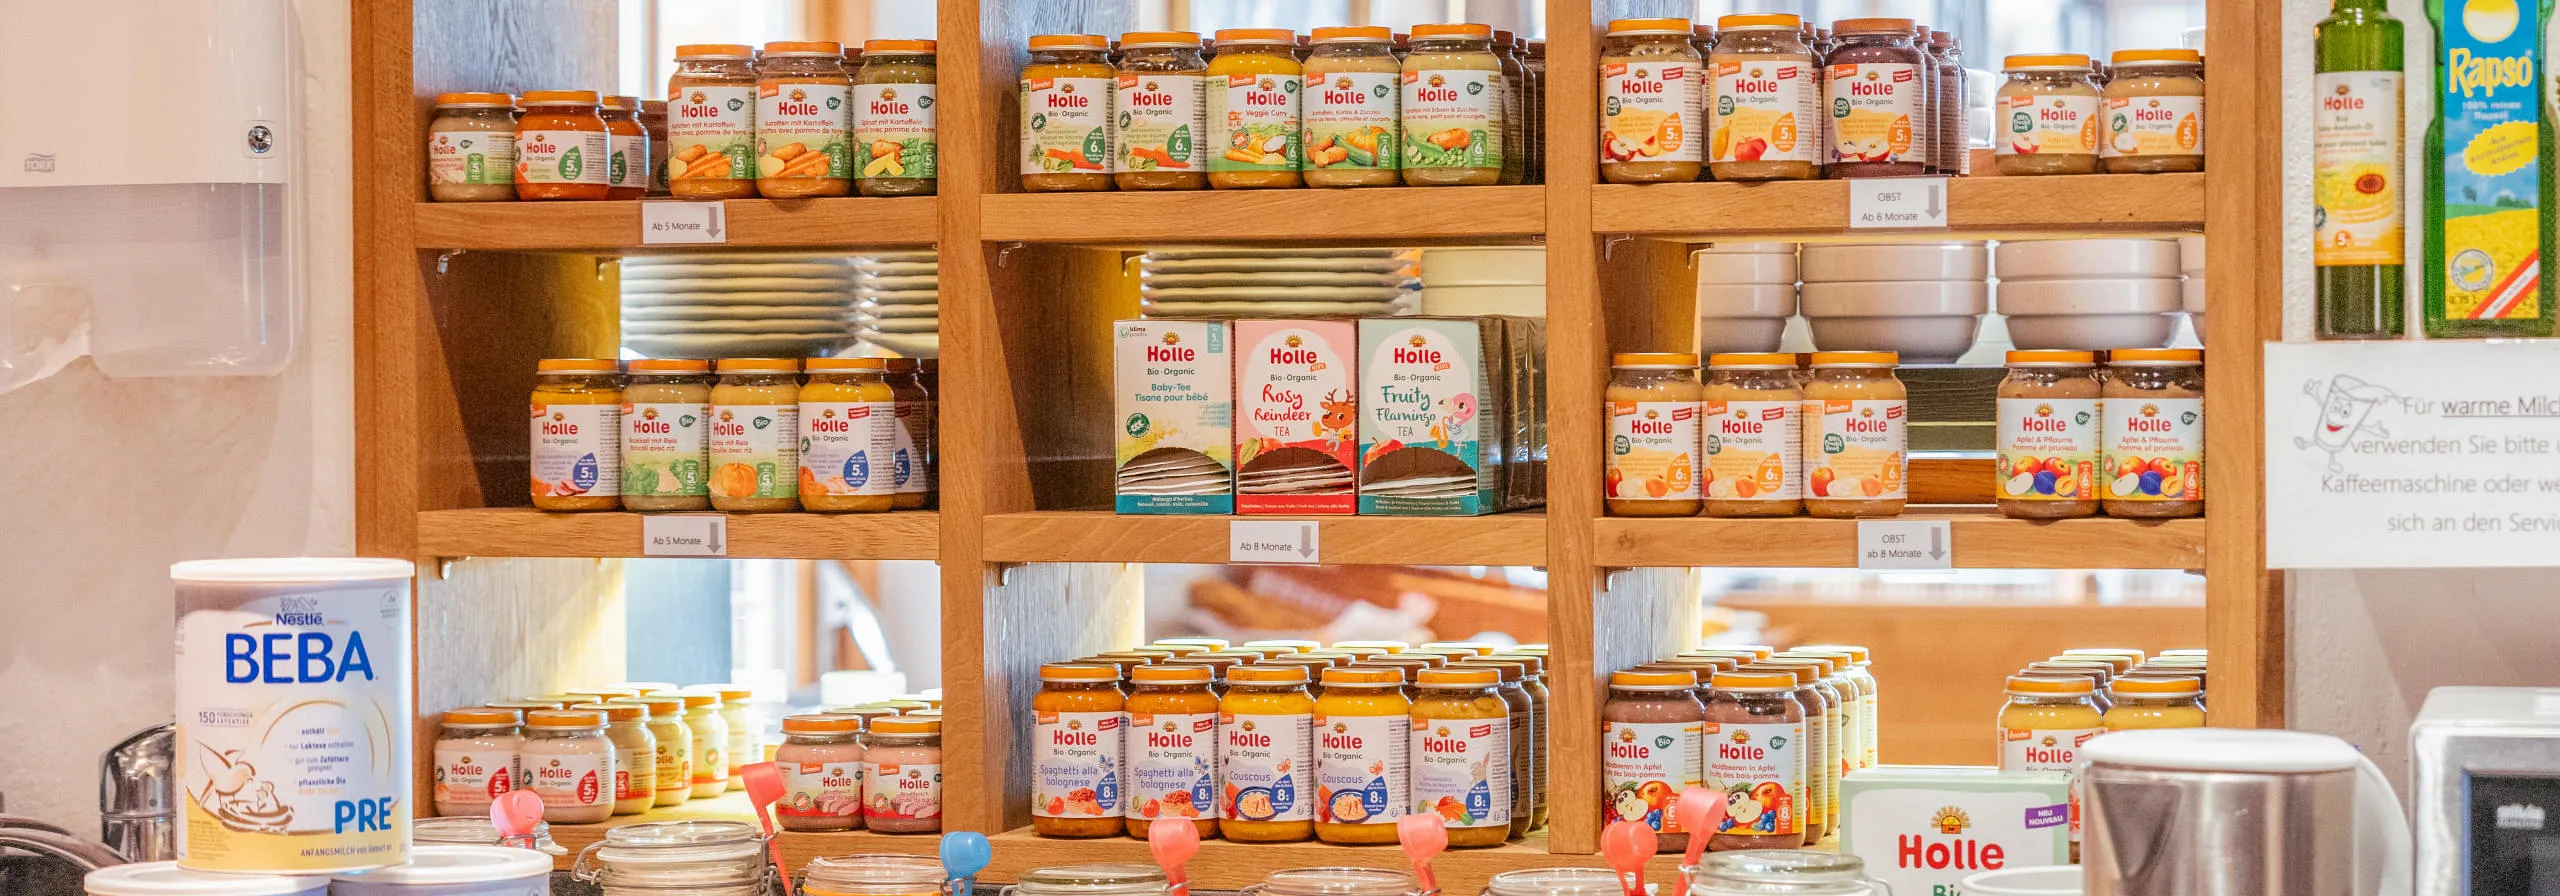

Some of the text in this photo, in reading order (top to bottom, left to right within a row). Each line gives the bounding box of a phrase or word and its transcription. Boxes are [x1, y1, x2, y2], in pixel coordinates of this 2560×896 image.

[2449, 48, 2533, 98] Rapso
[1622, 79, 1663, 94] Holle
[1735, 79, 1778, 93] Holle
[1851, 81, 1893, 96] Holle
[1048, 93, 1088, 108] Holle
[1132, 92, 1172, 106] Holle
[1246, 91, 1286, 106] Holle
[1324, 90, 1365, 105] Holle
[1417, 87, 1458, 102] Holle
[778, 101, 818, 116] Holle
[870, 100, 908, 115] Holle
[2323, 97, 2364, 110] Holle
[681, 104, 718, 118] Holle
[1246, 109, 1287, 117] Veggie Curry
[2040, 107, 2077, 121] Holle
[2135, 108, 2173, 121] Holle
[526, 142, 556, 154] Holle
[1877, 192, 1902, 202] OBST
[1862, 211, 1918, 222] Ab 6 Monate
[652, 222, 700, 231] Ab 5 Monate
[1147, 346, 1195, 362] Holle
[1270, 348, 1317, 364] Holle
[1394, 347, 1441, 364] Holle
[1164, 368, 1195, 377] Organic
[1286, 374, 1317, 383] Organic
[1410, 374, 1441, 383] Organic
[1151, 383, 1191, 392] Baby-Tee
[1135, 393, 1209, 403] Tisane pour bébé
[1262, 384, 1303, 410] Rosy
[1381, 385, 1430, 411] Fruity
[2403, 396, 2560, 416] Für warme Milc
[1254, 408, 1312, 421] Reindeer
[1376, 408, 1436, 427] Flamingo
[542, 422, 578, 435] Holle
[634, 420, 671, 434] Holle
[755, 417, 769, 427] Bio
[812, 419, 849, 433] Holle
[1631, 420, 1673, 434] Holle
[1722, 419, 1763, 434] Holle
[1846, 418, 1887, 432] Holle
[2023, 417, 2067, 432] Holle
[2128, 417, 2172, 432] Holle
[713, 422, 744, 436] Holle
[1274, 426, 1290, 437] TEA
[1398, 426, 1414, 437] TEA
[2016, 436, 2034, 444] Apfel
[2122, 436, 2140, 444] Apfel
[2350, 435, 2549, 454] verwenden Sie bitte
[2322, 474, 2477, 493] Kaffeemaschine
[2483, 474, 2530, 492] oder
[2387, 513, 2425, 531] sich
[2432, 517, 2456, 531] an
[2463, 513, 2501, 531] den
[653, 536, 701, 545] Ab 5 Monate
[1881, 534, 1906, 544] OBST
[1240, 542, 1292, 552] Ab 8 Monate
[1867, 549, 1921, 558] ab 8 Monate
[276, 612, 323, 626] Nestlé
[226, 631, 374, 684] BEBA
[199, 711, 216, 724] 150
[301, 727, 325, 735] enthält
[1053, 730, 1097, 745] Holle
[1148, 732, 1193, 748] Holle
[1229, 731, 1271, 747] Holle
[1322, 733, 1363, 749] Holle
[1424, 737, 1467, 753] Holle
[1657, 737, 1671, 747] Bio
[1771, 738, 1785, 747] Bio
[1610, 742, 1649, 759] Holle
[1719, 743, 1764, 760] Holle
[2026, 747, 2073, 764] Holle
[320, 755, 349, 763] Zufüttern
[451, 763, 483, 776] Holle
[539, 766, 572, 779] Holle
[1040, 764, 1098, 776] Spaghetti alla
[1134, 767, 1194, 779] Spaghetti alla
[1643, 763, 1662, 772] Apfel
[1758, 764, 1776, 772] Apfel
[1229, 771, 1271, 782] Couscous
[1322, 773, 1363, 784] Couscous
[1623, 771, 1666, 779] bois-pomme
[1736, 772, 1780, 780] bois-pomme
[823, 777, 851, 787] Holle
[900, 779, 930, 789] Holle
[1046, 777, 1090, 788] bolognese
[1141, 780, 1186, 791] bolognese
[335, 796, 392, 834] PRE
[2029, 815, 2063, 826] NOUVEAU
[2038, 809, 2053, 819] NEU
[300, 847, 355, 857] ANFANGSMILCH
[1897, 834, 2004, 870] Holle
